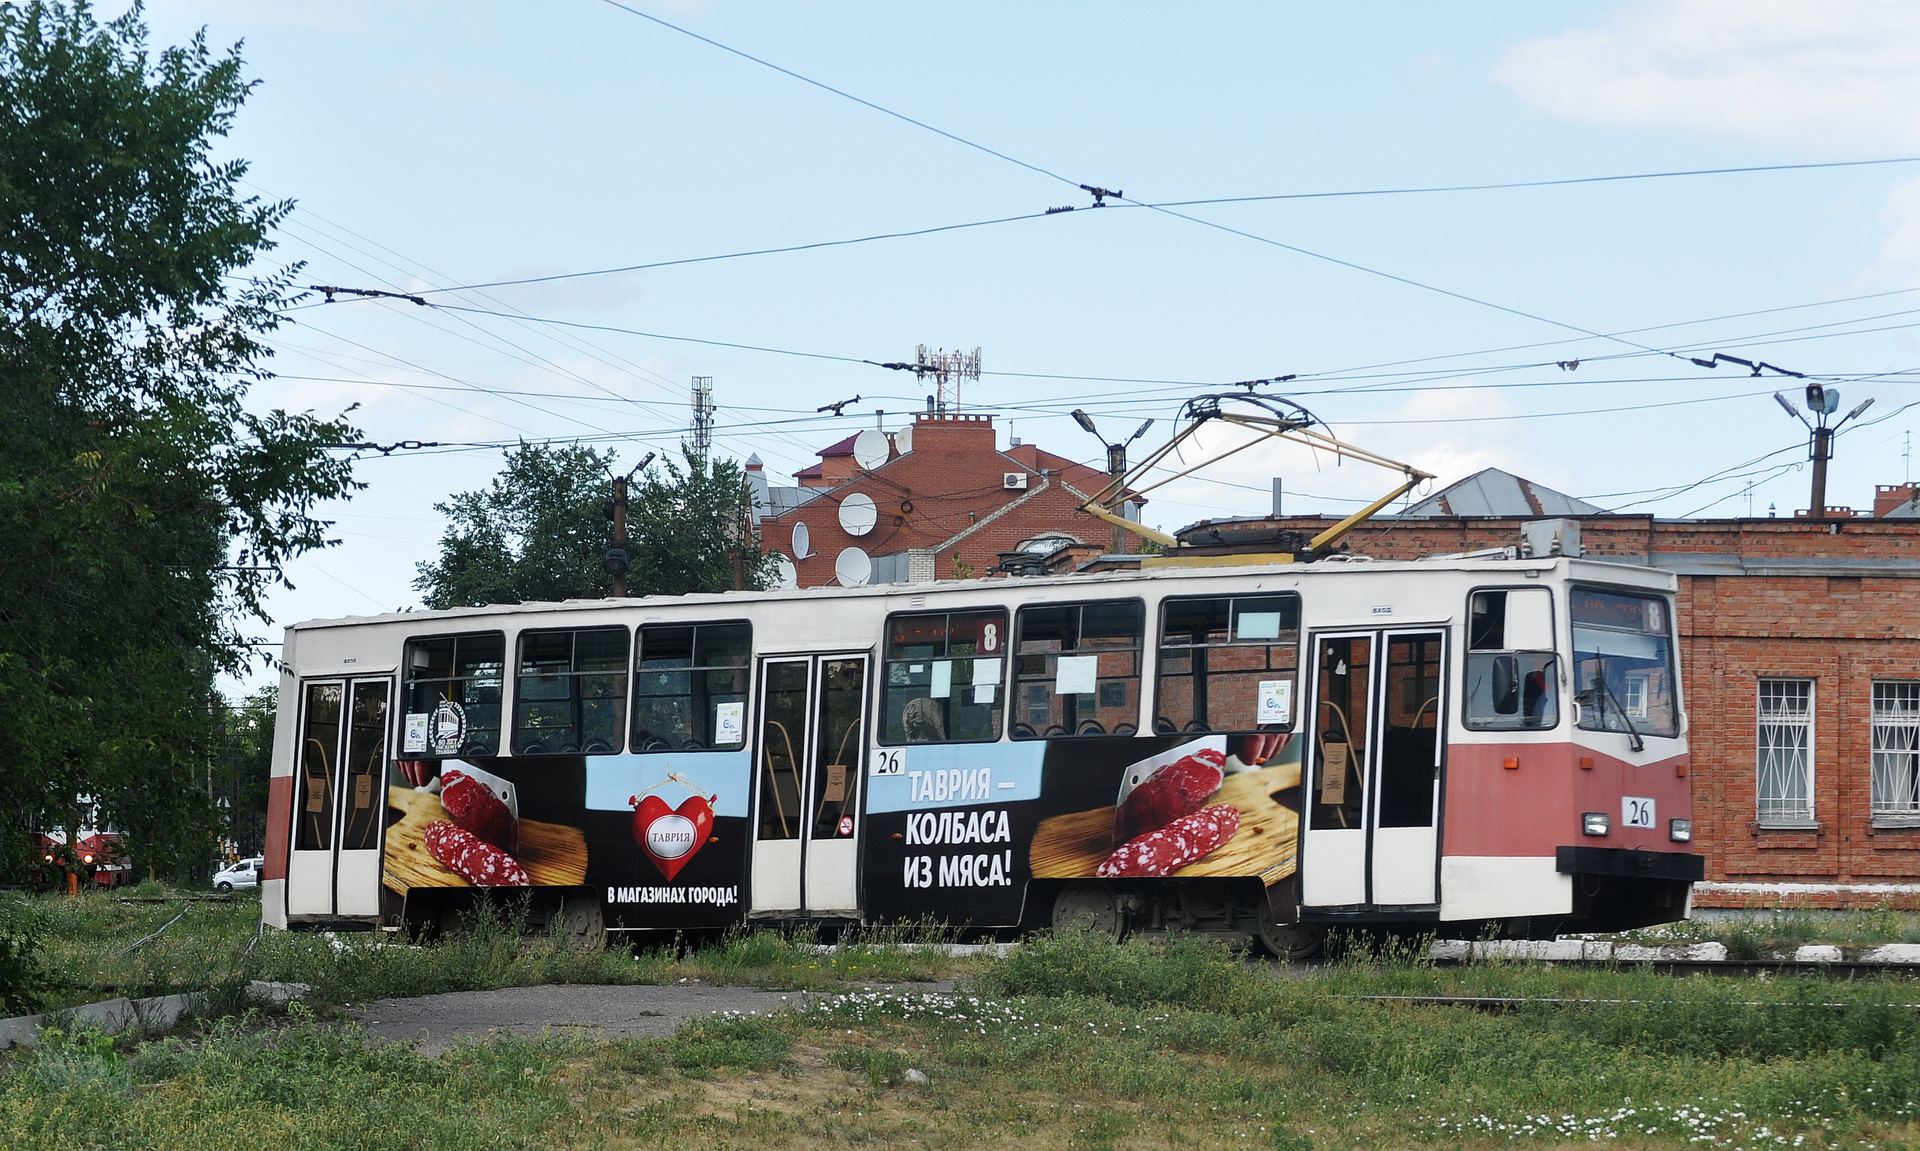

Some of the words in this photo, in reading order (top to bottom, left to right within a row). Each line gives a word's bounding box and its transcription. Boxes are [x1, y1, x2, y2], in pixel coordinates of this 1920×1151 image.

[1648, 602, 1660, 631] 8
[983, 623, 997, 651] 8
[877, 750, 899, 774] 26
[908, 767, 991, 802] ТАВРИЯ
[1630, 800, 1649, 826] 26
[652, 832, 691, 843] ТАВРИЯ
[905, 810, 1011, 845] КОЛБАСА
[903, 855, 934, 888] ИЗ
[938, 849, 1012, 888] МЯСА!
[607, 886, 616, 903] В
[617, 886, 686, 904] МАГАЗИНАХ
[688, 885, 738, 907] ГОРОДА!
